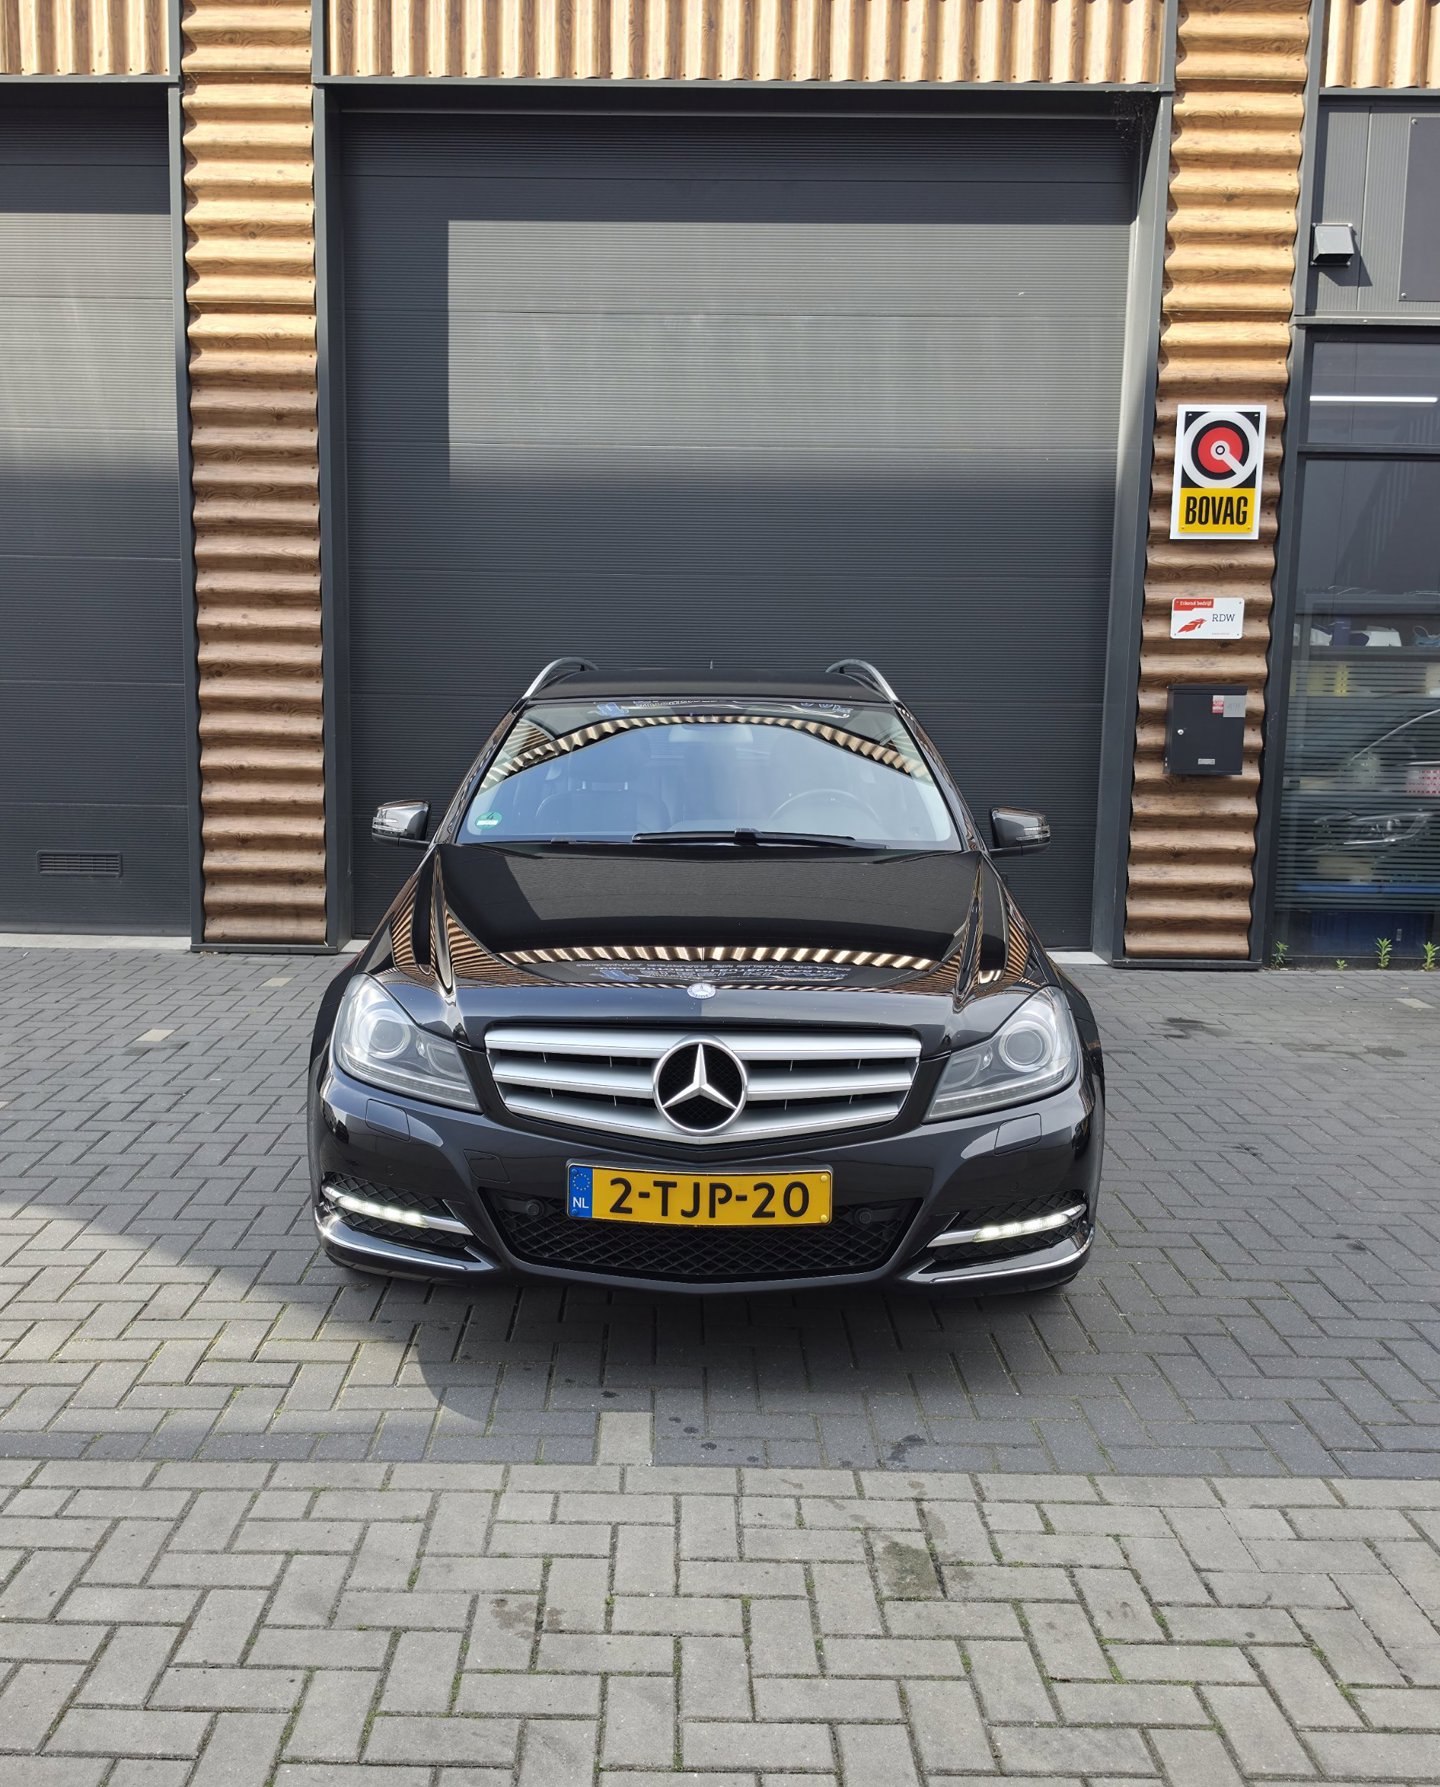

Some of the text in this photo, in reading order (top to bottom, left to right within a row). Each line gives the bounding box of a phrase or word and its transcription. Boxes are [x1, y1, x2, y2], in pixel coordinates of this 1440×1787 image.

[1185, 496, 1248, 525] BOVAG
[1212, 613, 1235, 622] RDW
[572, 1196, 589, 1209] NL
[609, 1177, 809, 1219] 2-TJP-20
